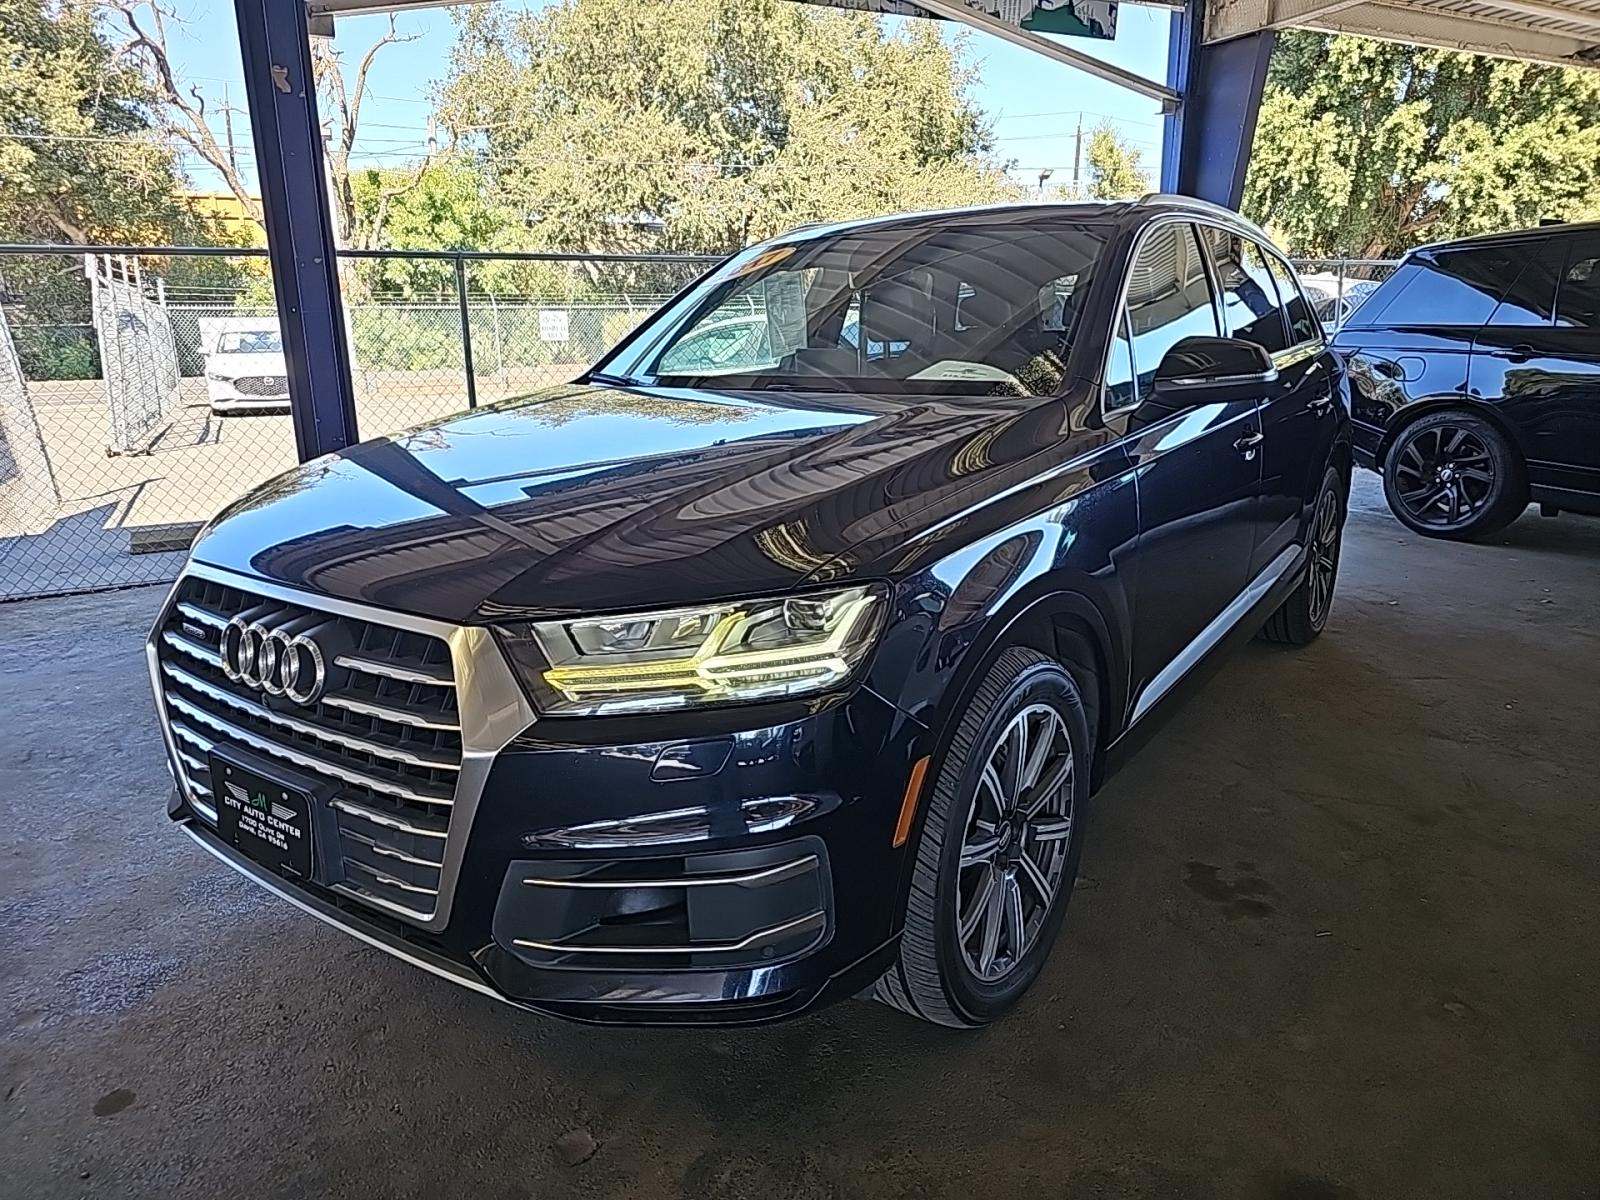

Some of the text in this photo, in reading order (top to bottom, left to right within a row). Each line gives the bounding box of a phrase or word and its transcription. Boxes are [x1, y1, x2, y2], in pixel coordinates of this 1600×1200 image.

[224, 796, 301, 839] CITY AUTO CENTER
